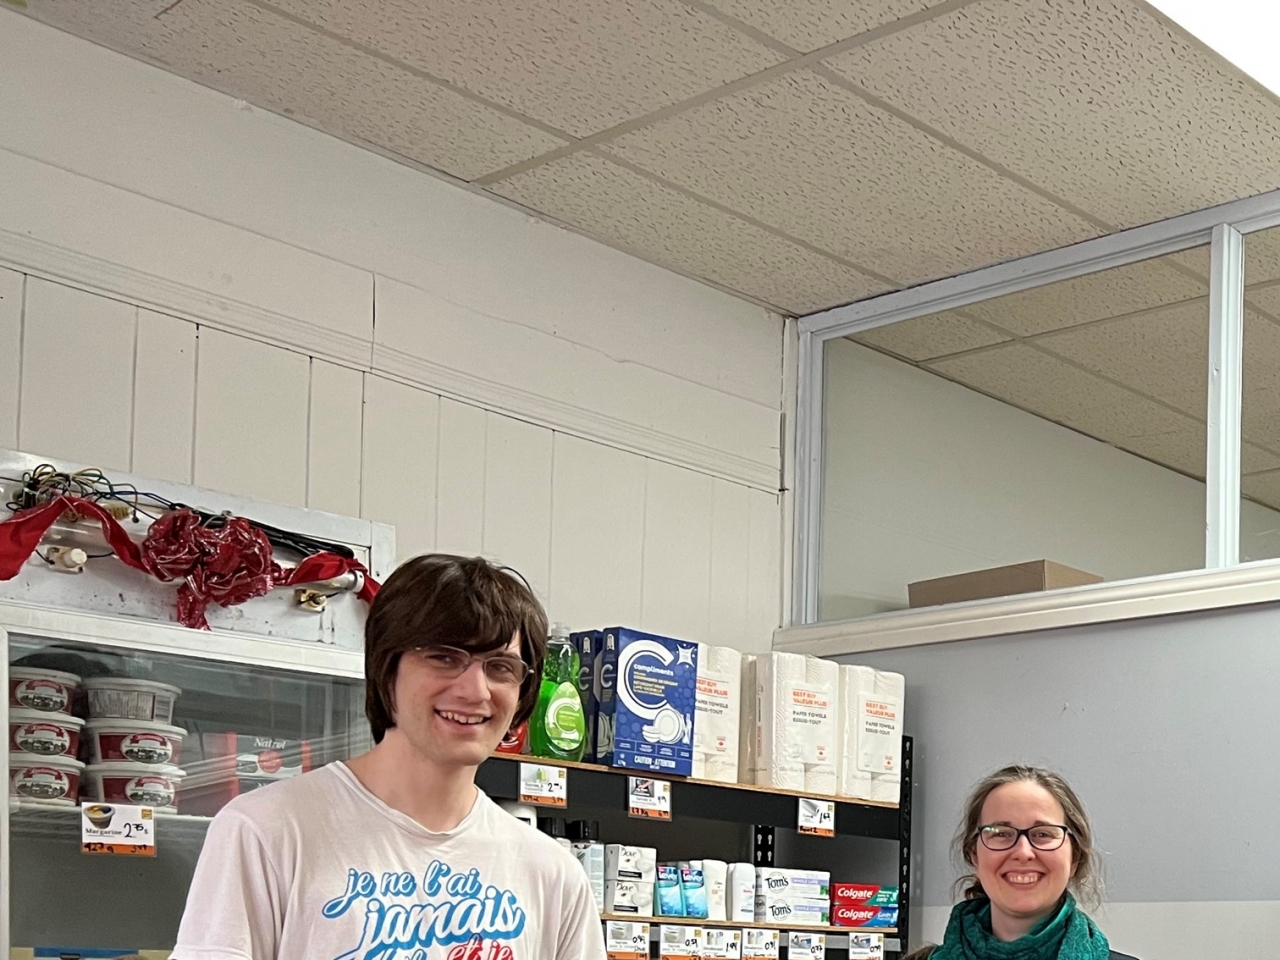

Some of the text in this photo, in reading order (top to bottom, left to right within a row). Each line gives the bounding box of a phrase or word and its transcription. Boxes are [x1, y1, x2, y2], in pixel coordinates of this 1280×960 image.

[633, 663, 674, 676] compliments
[85, 828, 122, 836] Margarine
[620, 848, 638, 858] Dove
[616, 882, 634, 892] Dove
[764, 876, 789, 889] Tom's
[322, 859, 482, 919] je ne l'ai
[837, 887, 873, 899] Colgate
[769, 904, 792, 917] Tom's
[837, 908, 874, 920] Colgate
